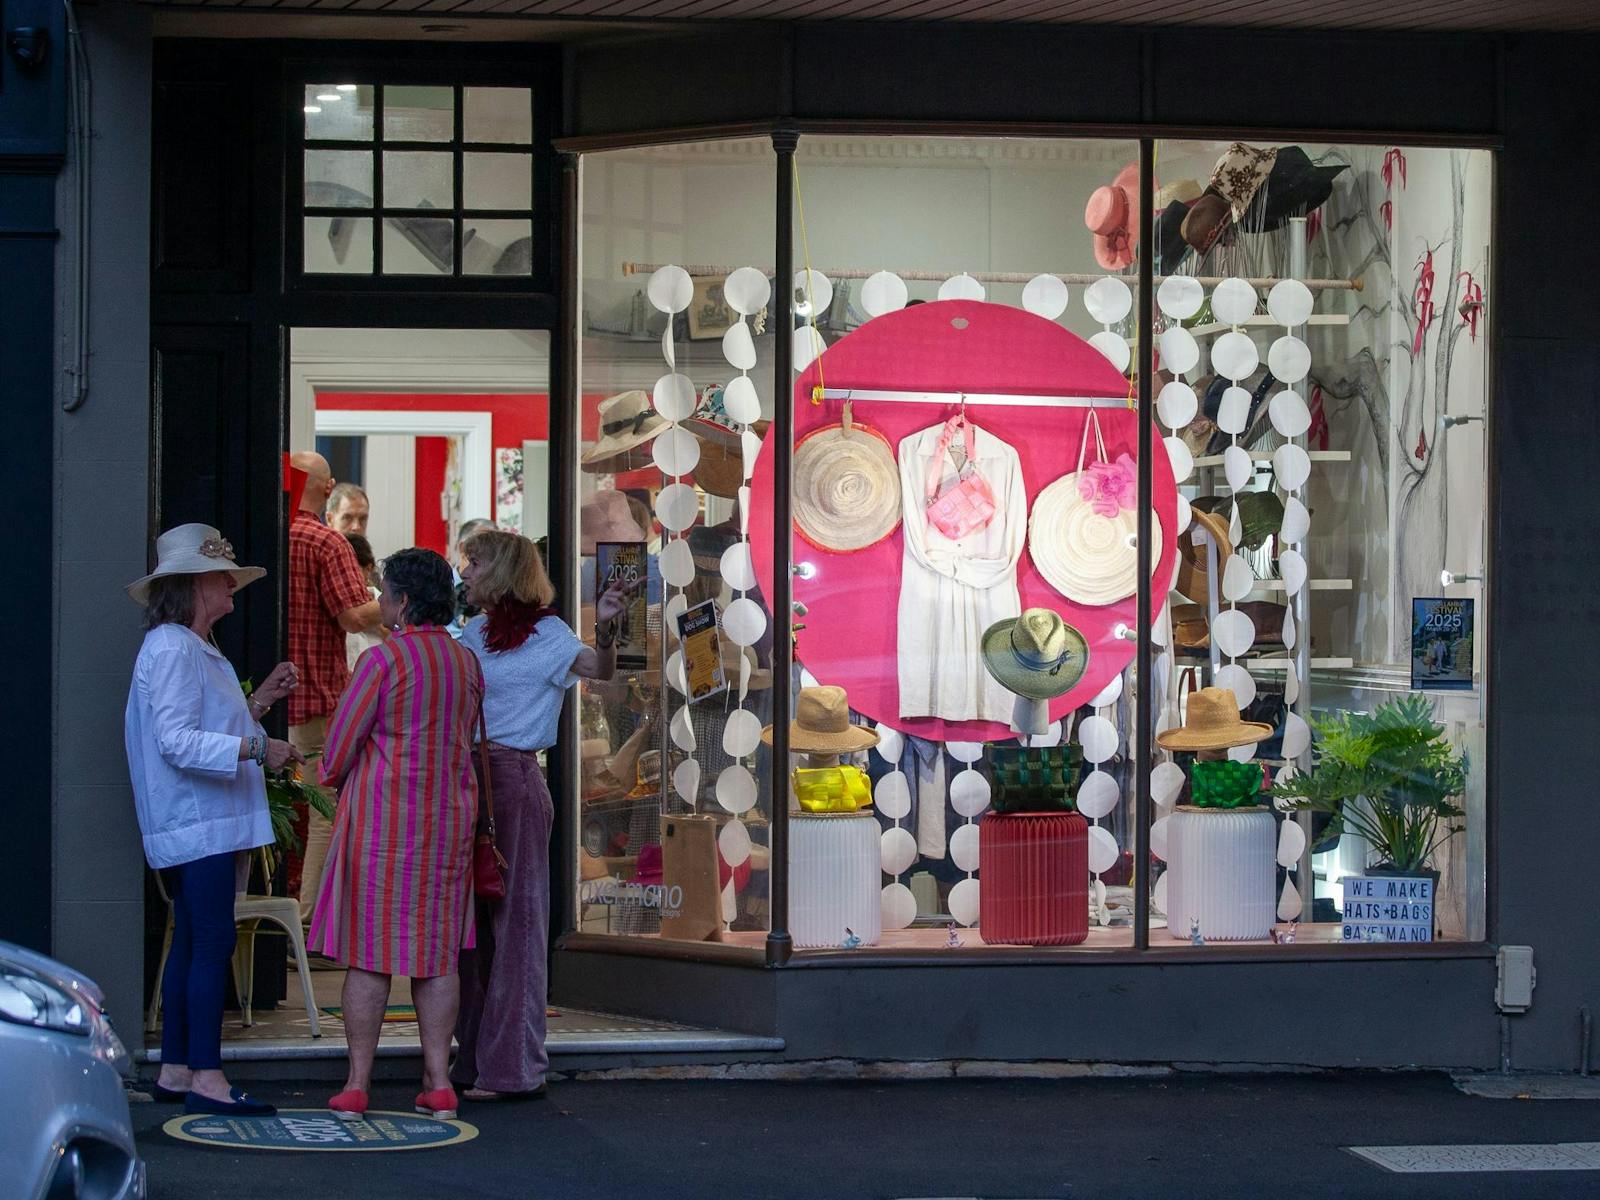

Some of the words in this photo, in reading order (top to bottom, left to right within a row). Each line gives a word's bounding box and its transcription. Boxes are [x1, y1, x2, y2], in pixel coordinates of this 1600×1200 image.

[608, 564, 638, 581] 2025
[1425, 613, 1462, 627] 2025
[1352, 882, 1374, 896] WE
[1387, 882, 1428, 898] MAKE
[279, 1117, 352, 1143] 2025
